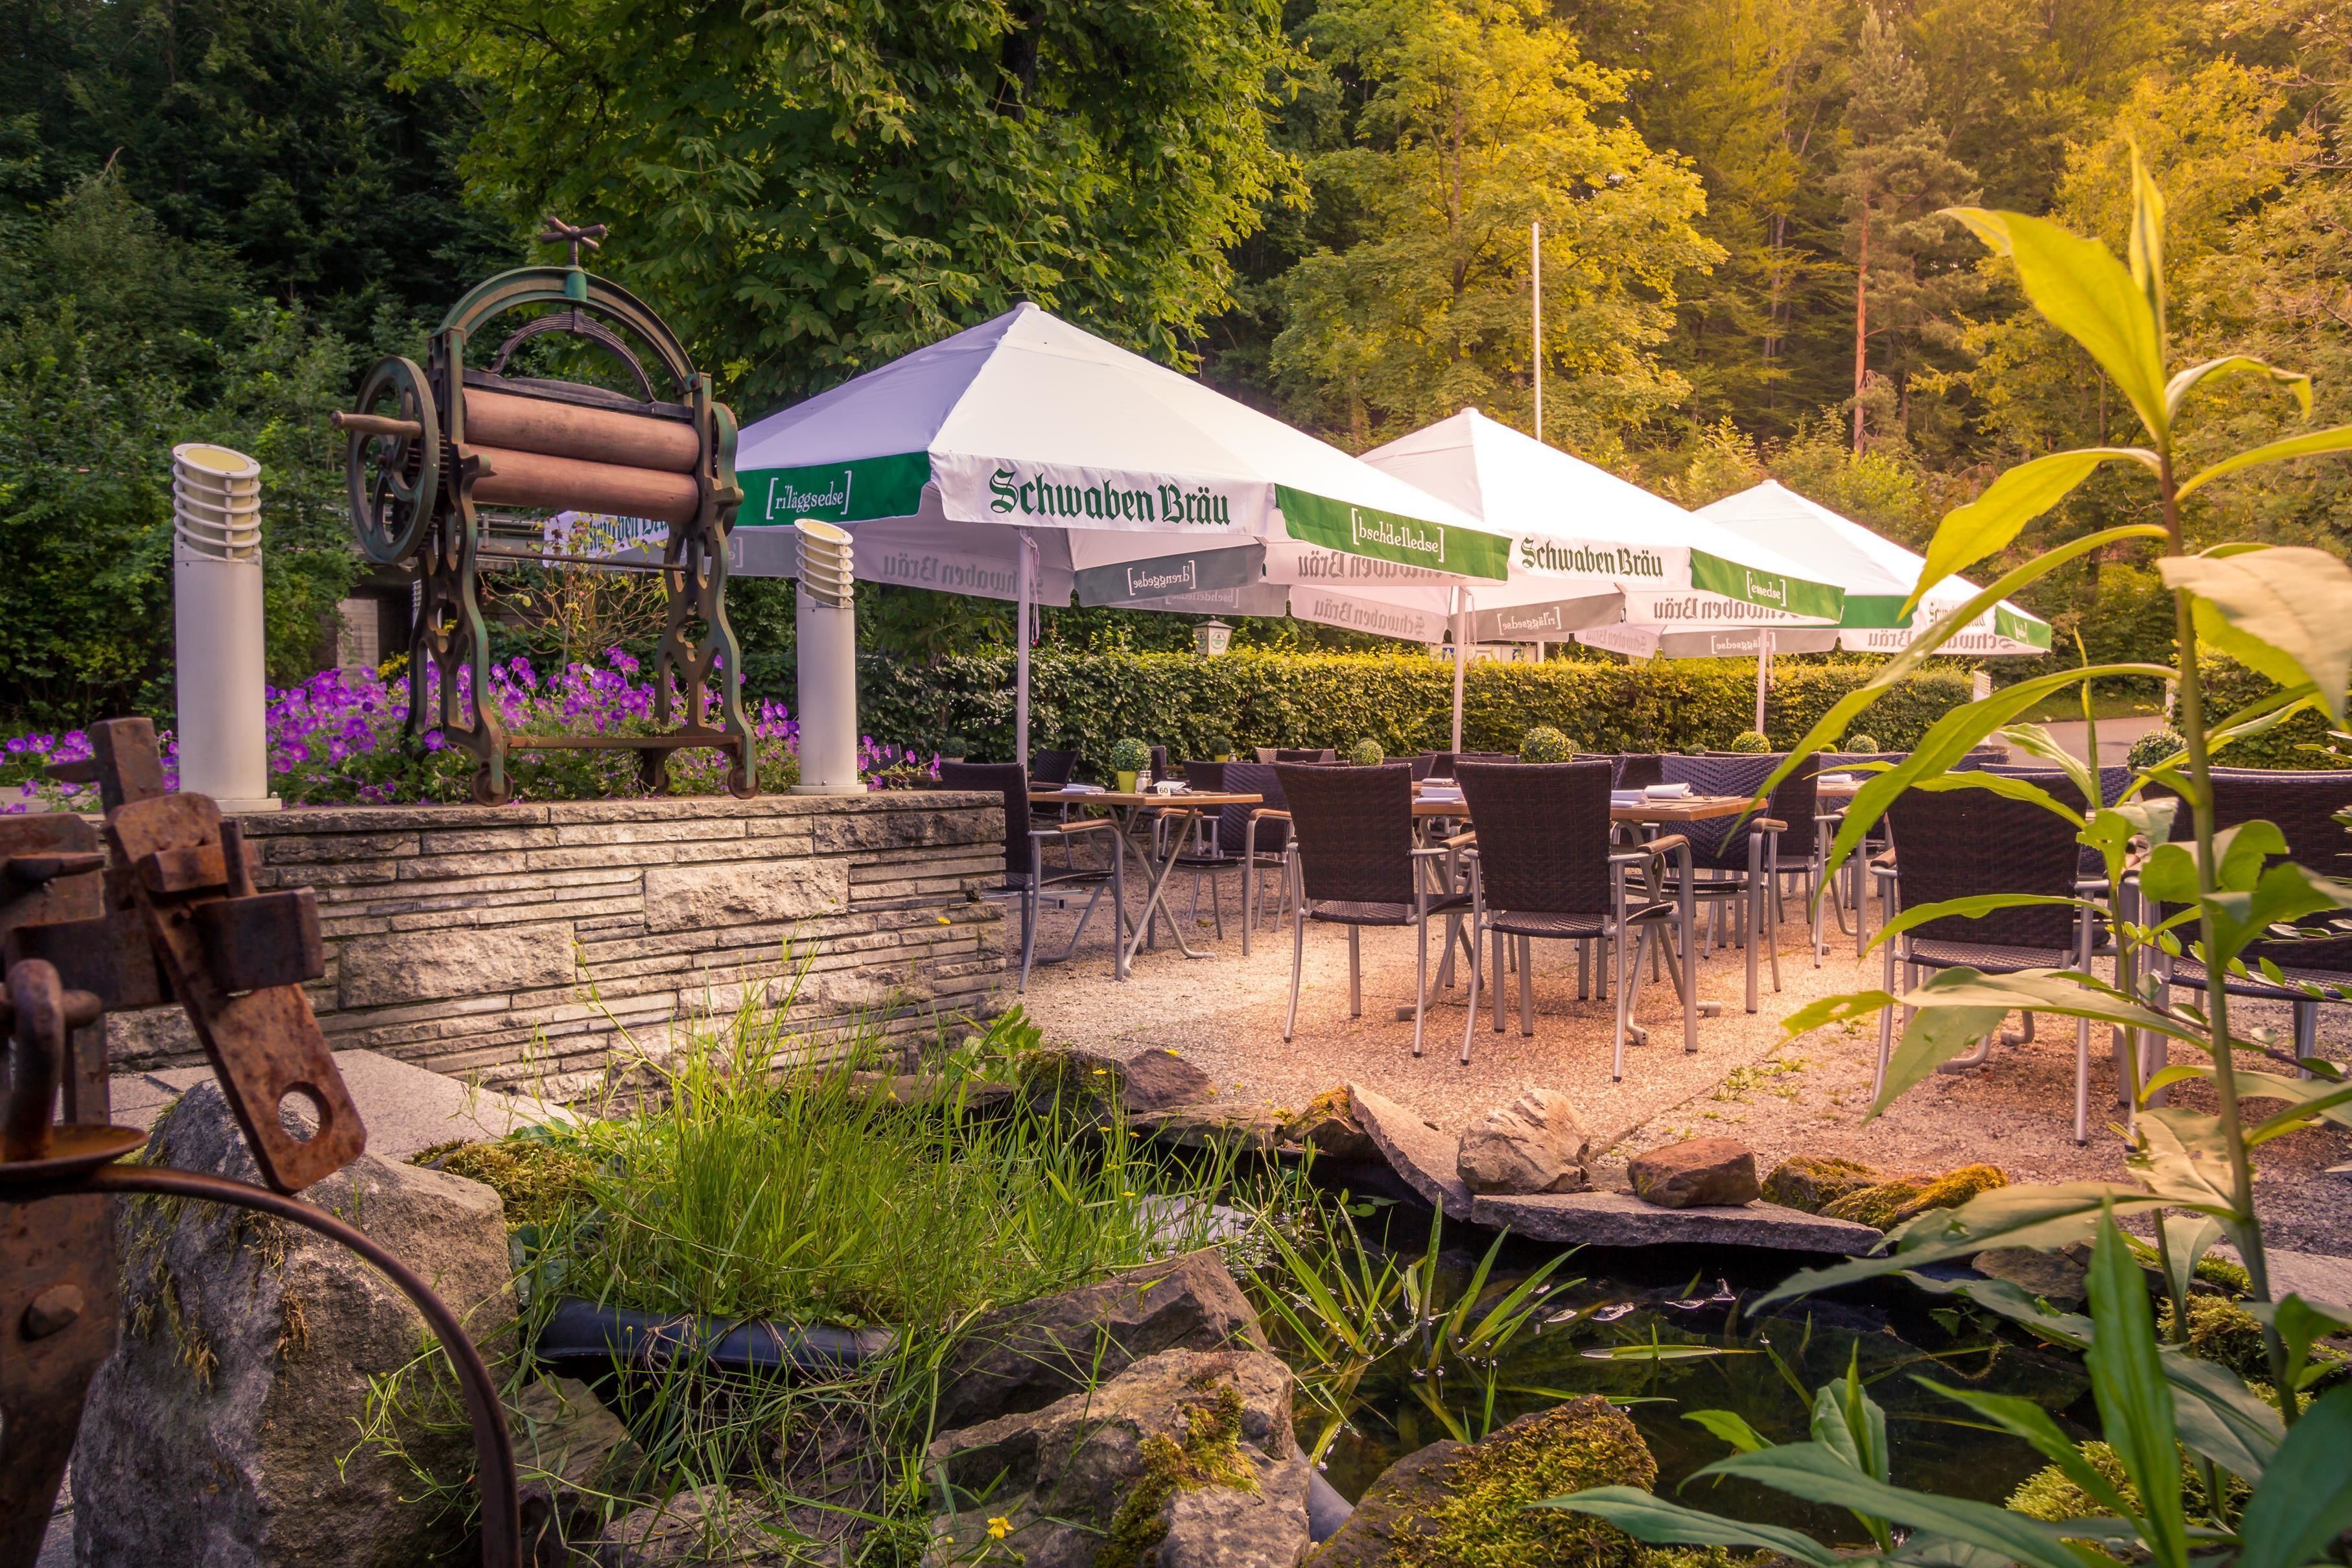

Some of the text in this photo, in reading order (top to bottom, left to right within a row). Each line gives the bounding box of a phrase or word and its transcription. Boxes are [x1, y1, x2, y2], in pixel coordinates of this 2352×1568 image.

[989, 468, 1231, 526] Schwaben Bräu
[1521, 537, 1664, 577] Schwaben Bräu
